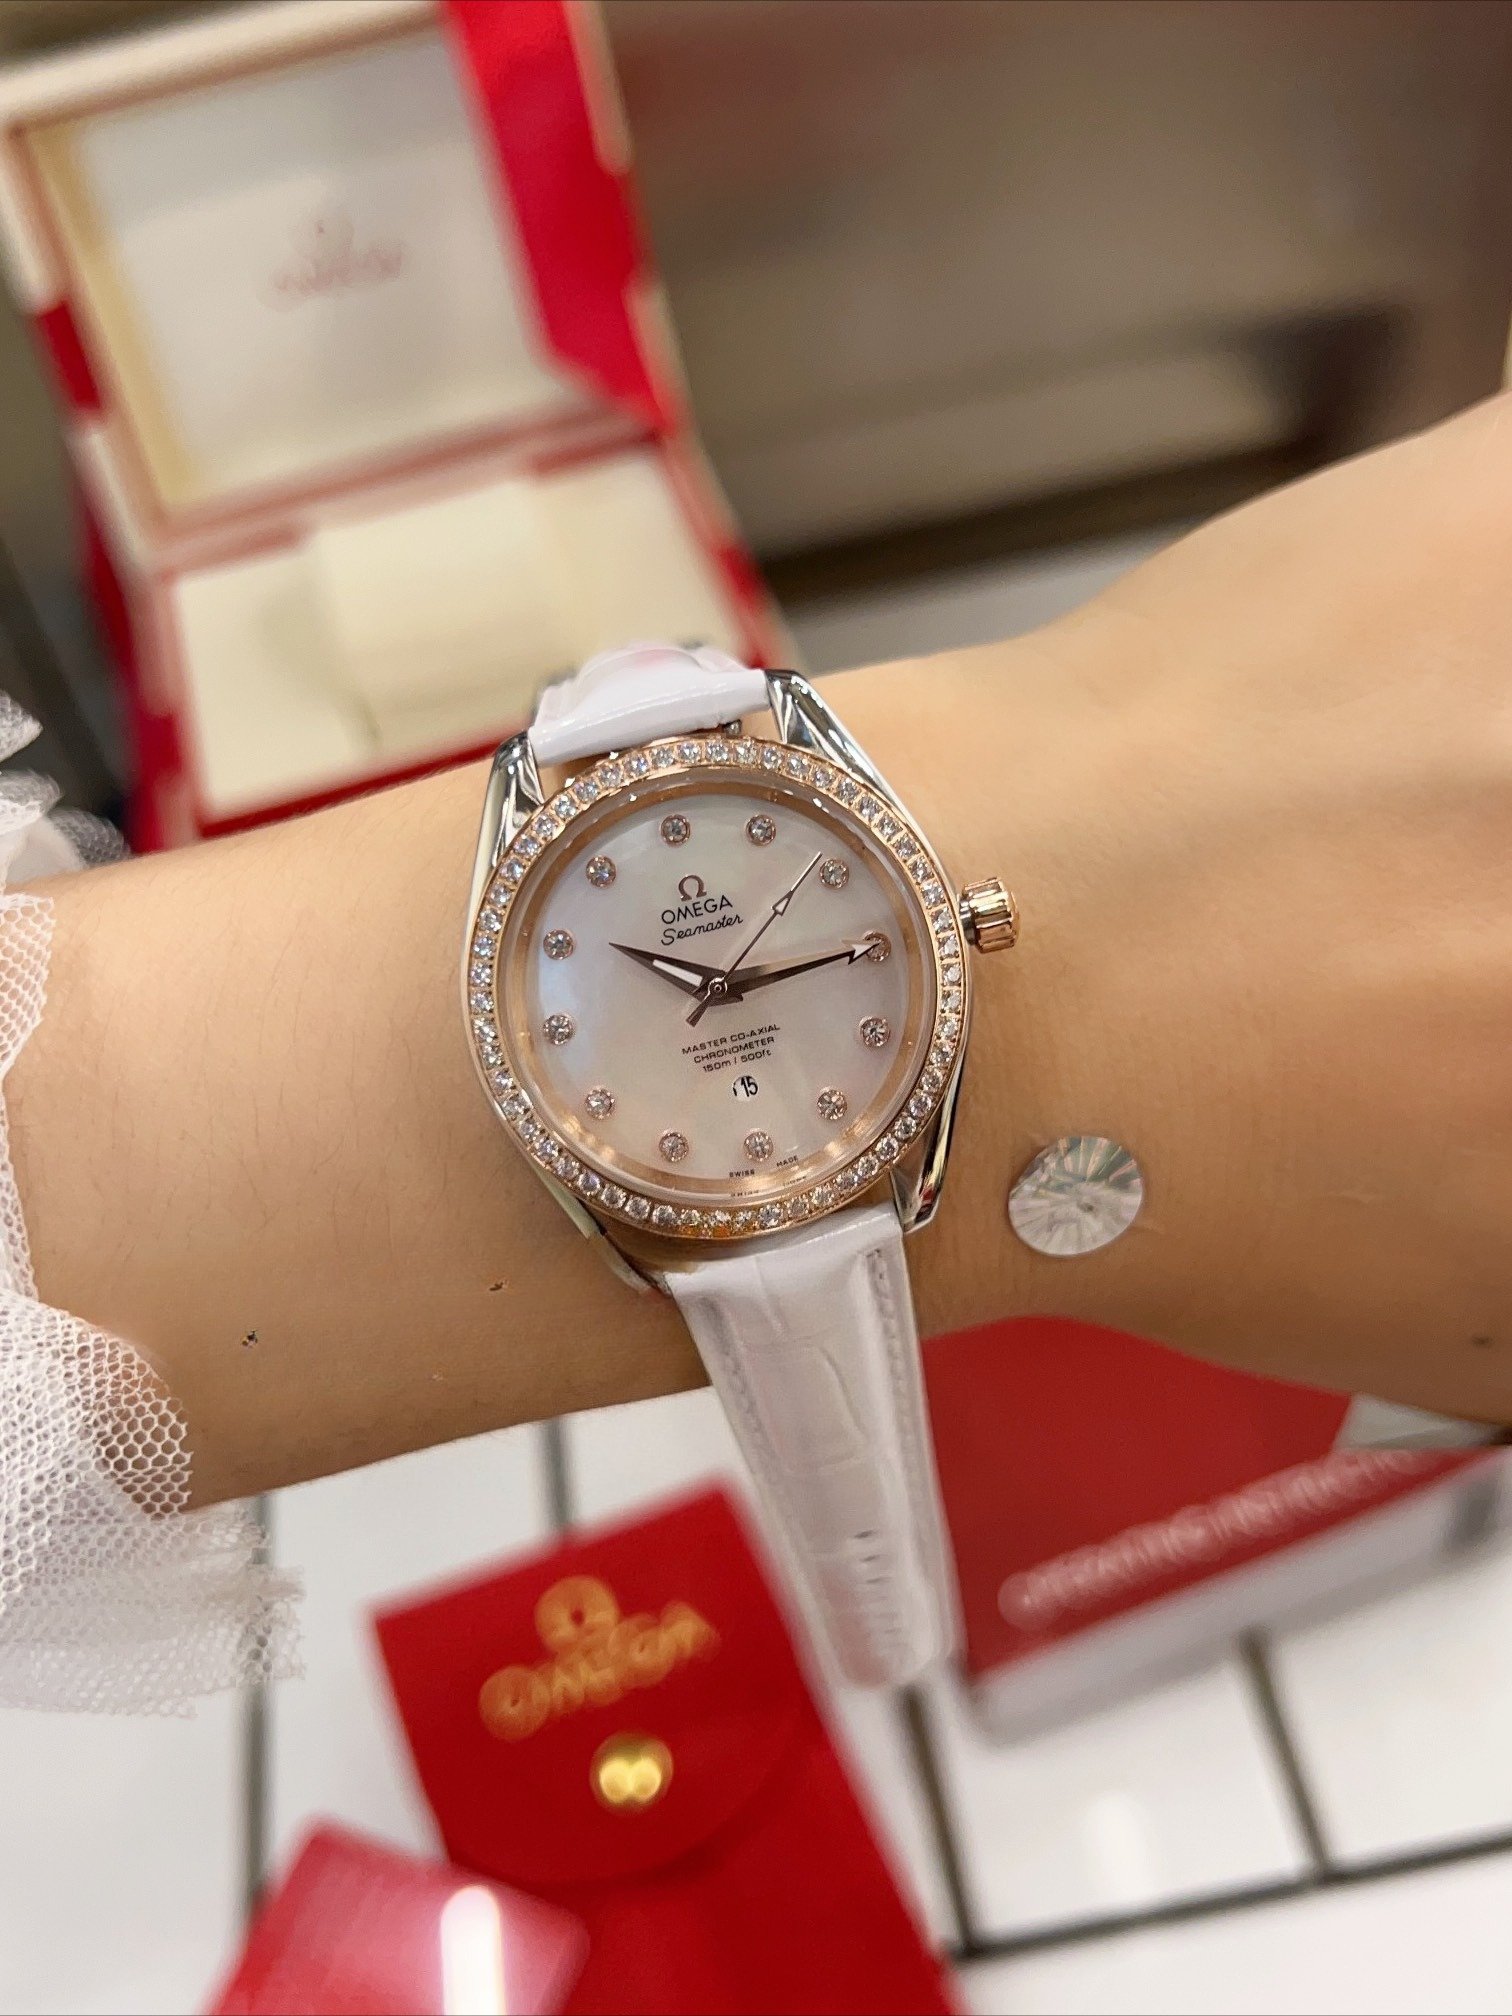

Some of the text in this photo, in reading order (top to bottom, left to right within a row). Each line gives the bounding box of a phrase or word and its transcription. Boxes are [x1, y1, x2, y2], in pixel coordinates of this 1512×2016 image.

[661, 895, 733, 925] OMEGA
[661, 914, 743, 946] Seamaster
[682, 1024, 780, 1055] MASTER CO-AXIAL
[693, 1036, 775, 1064] CHRONOMETER
[702, 1058, 731, 1073] 150m
[741, 1049, 772, 1064] 500ft
[776, 1155, 799, 1167] MADE
